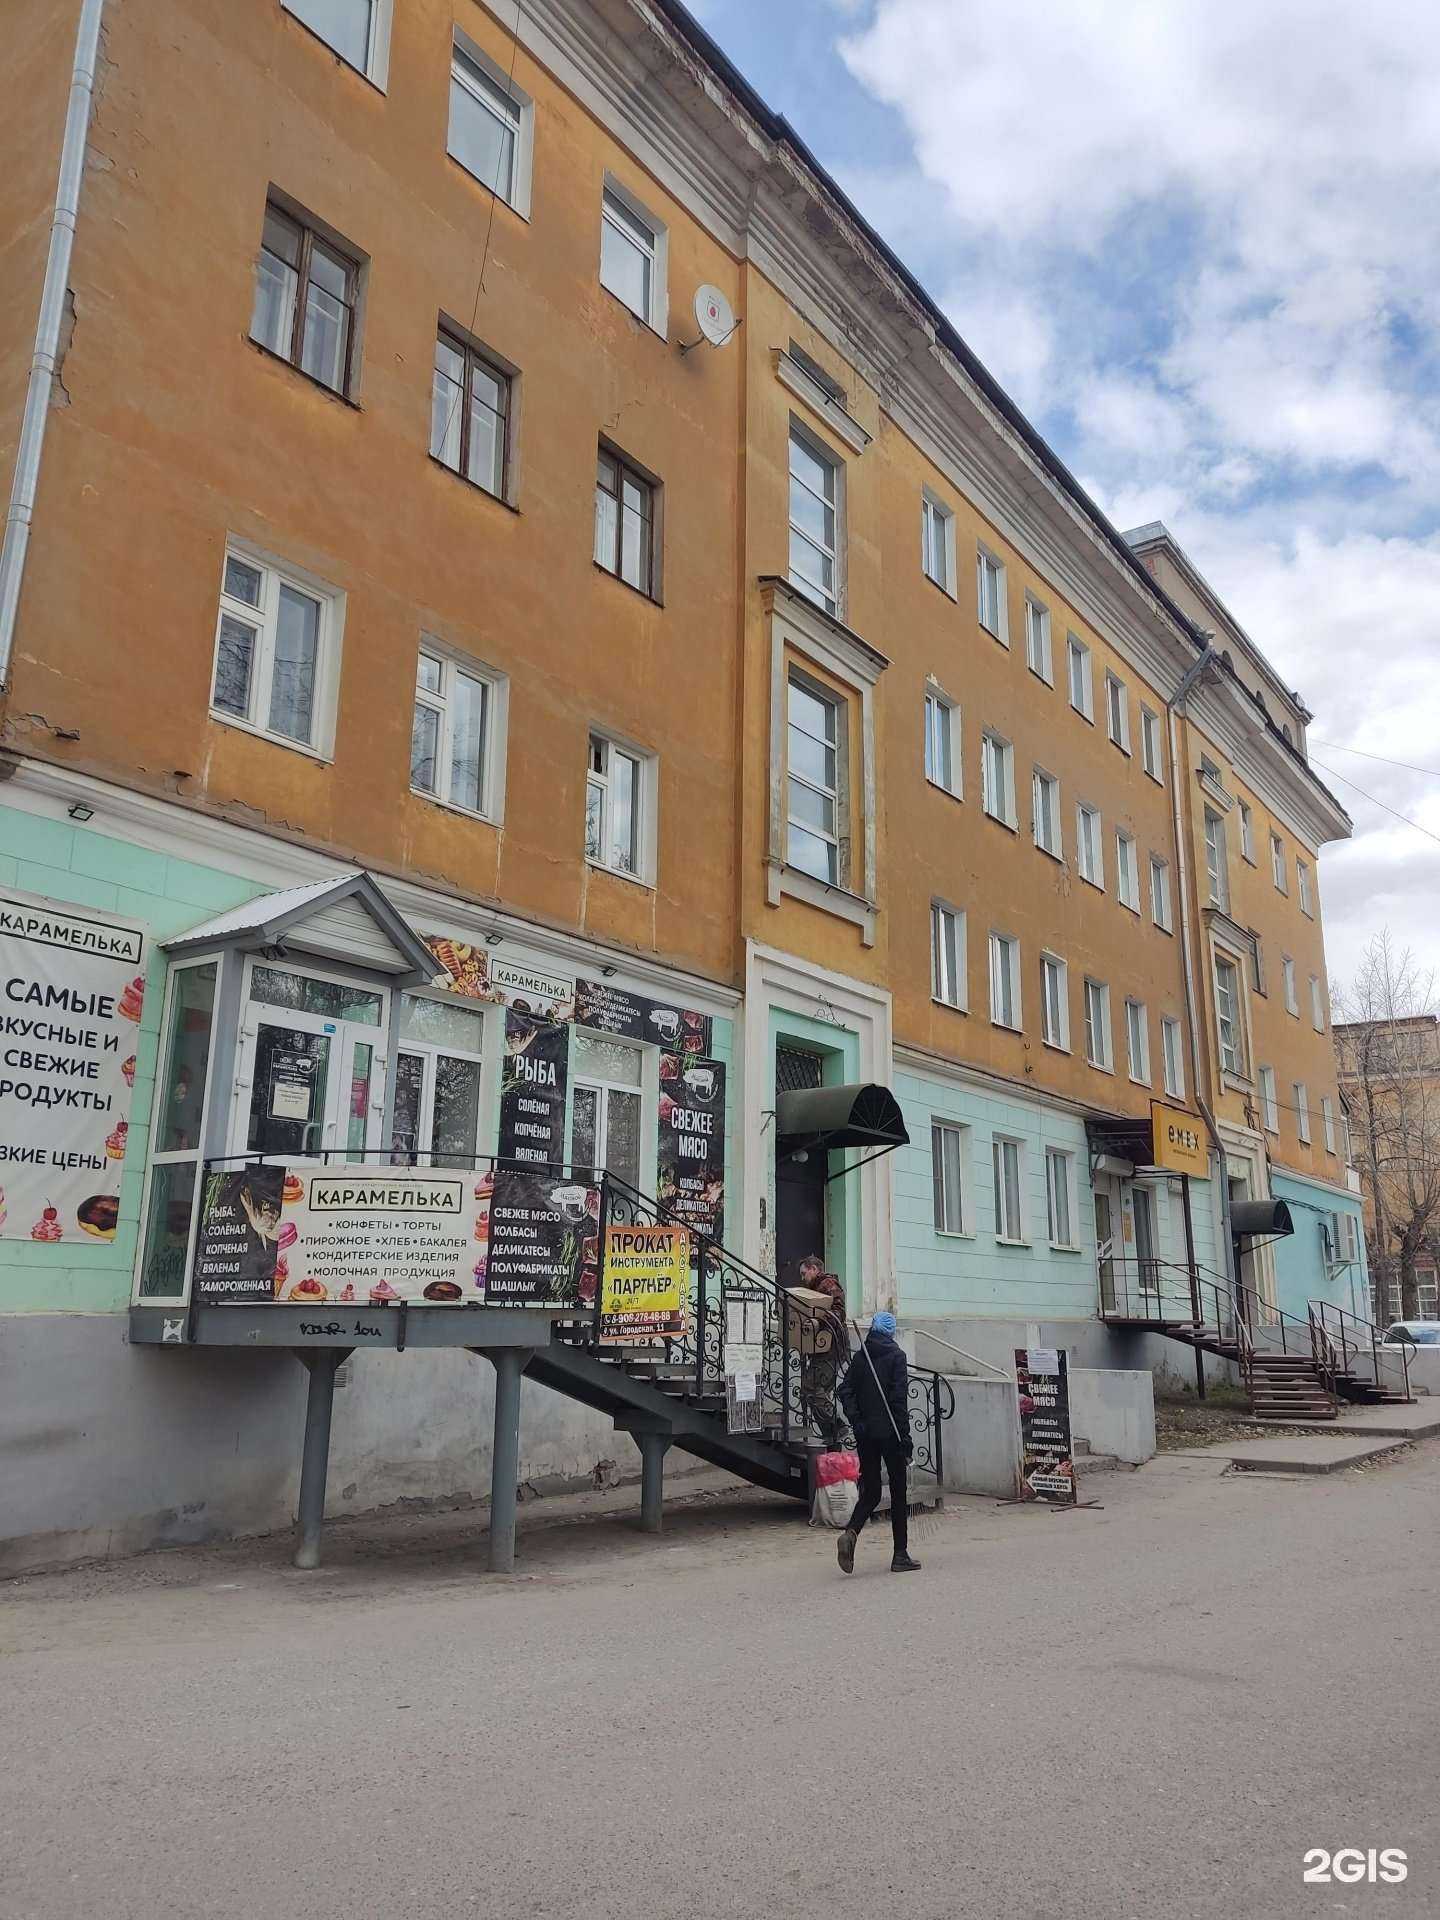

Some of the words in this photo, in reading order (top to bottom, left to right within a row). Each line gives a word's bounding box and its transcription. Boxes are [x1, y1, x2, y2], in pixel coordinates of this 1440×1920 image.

[0, 912, 133, 956] КАРАМЕЛЬКА
[497, 969, 567, 998] КАРАМЕЛЬКА
[5, 978, 115, 1019] САМЫЕ
[0, 1015, 98, 1049] КУСНЫЕ
[103, 1034, 119, 1052] И
[4, 1049, 100, 1079] СВЕЖИЕ
[516, 1055, 556, 1087] РЫБА
[0, 1080, 112, 1111] РОДУКТЫ
[518, 1098, 550, 1116] СОЛЁНАЯ
[671, 1106, 713, 1135] СВЕЖЕЕ
[514, 1121, 551, 1140] КОПЧЁНАЯ
[515, 1146, 548, 1163] ВЯЛЕНАЯ
[678, 1134, 708, 1160] МЯСО
[52, 1151, 107, 1171] ЦЕНЫ
[317, 1190, 454, 1207] КАРАМЕЛЬКА
[675, 1199, 710, 1213] ДЕЛИКАТЕСЫ
[209, 1206, 236, 1218] РЫБА:
[494, 1207, 530, 1220] СВЕЖЕЕ
[531, 1211, 561, 1223] МЯСО
[208, 1222, 247, 1236] СОЛЁНАЯ
[335, 1220, 392, 1230] КОНФЕТЫ
[404, 1221, 441, 1231] ТОРТЫ
[494, 1225, 538, 1238] КОЛБАСЫ
[305, 1236, 371, 1246] ПИРОЖНОЕ
[381, 1237, 410, 1247] ХЛЕБ
[419, 1237, 467, 1248] БАКАЛЕЯ
[491, 1243, 551, 1257] ДЕЛИКАТЕСЫ
[611, 1233, 674, 1254] ПРОКАТ
[312, 1251, 403, 1262] КОНДИТЕРСКИЕ
[406, 1252, 459, 1263] ИЗДЕЛИЯ
[611, 1256, 674, 1268] ИНСТРУМЕНТА
[202, 1262, 240, 1274] ВЯЛЕНАЯ
[313, 1266, 377, 1277] МОЛОЧНАЯ
[383, 1267, 455, 1279] ПРОДУКЦИЯ
[491, 1262, 570, 1276] ПОЛУФАБРИКАТЫ
[200, 1279, 272, 1292] ЗАМОРОЖЕННАЯ
[490, 1280, 536, 1292] ШАШЛЫК
